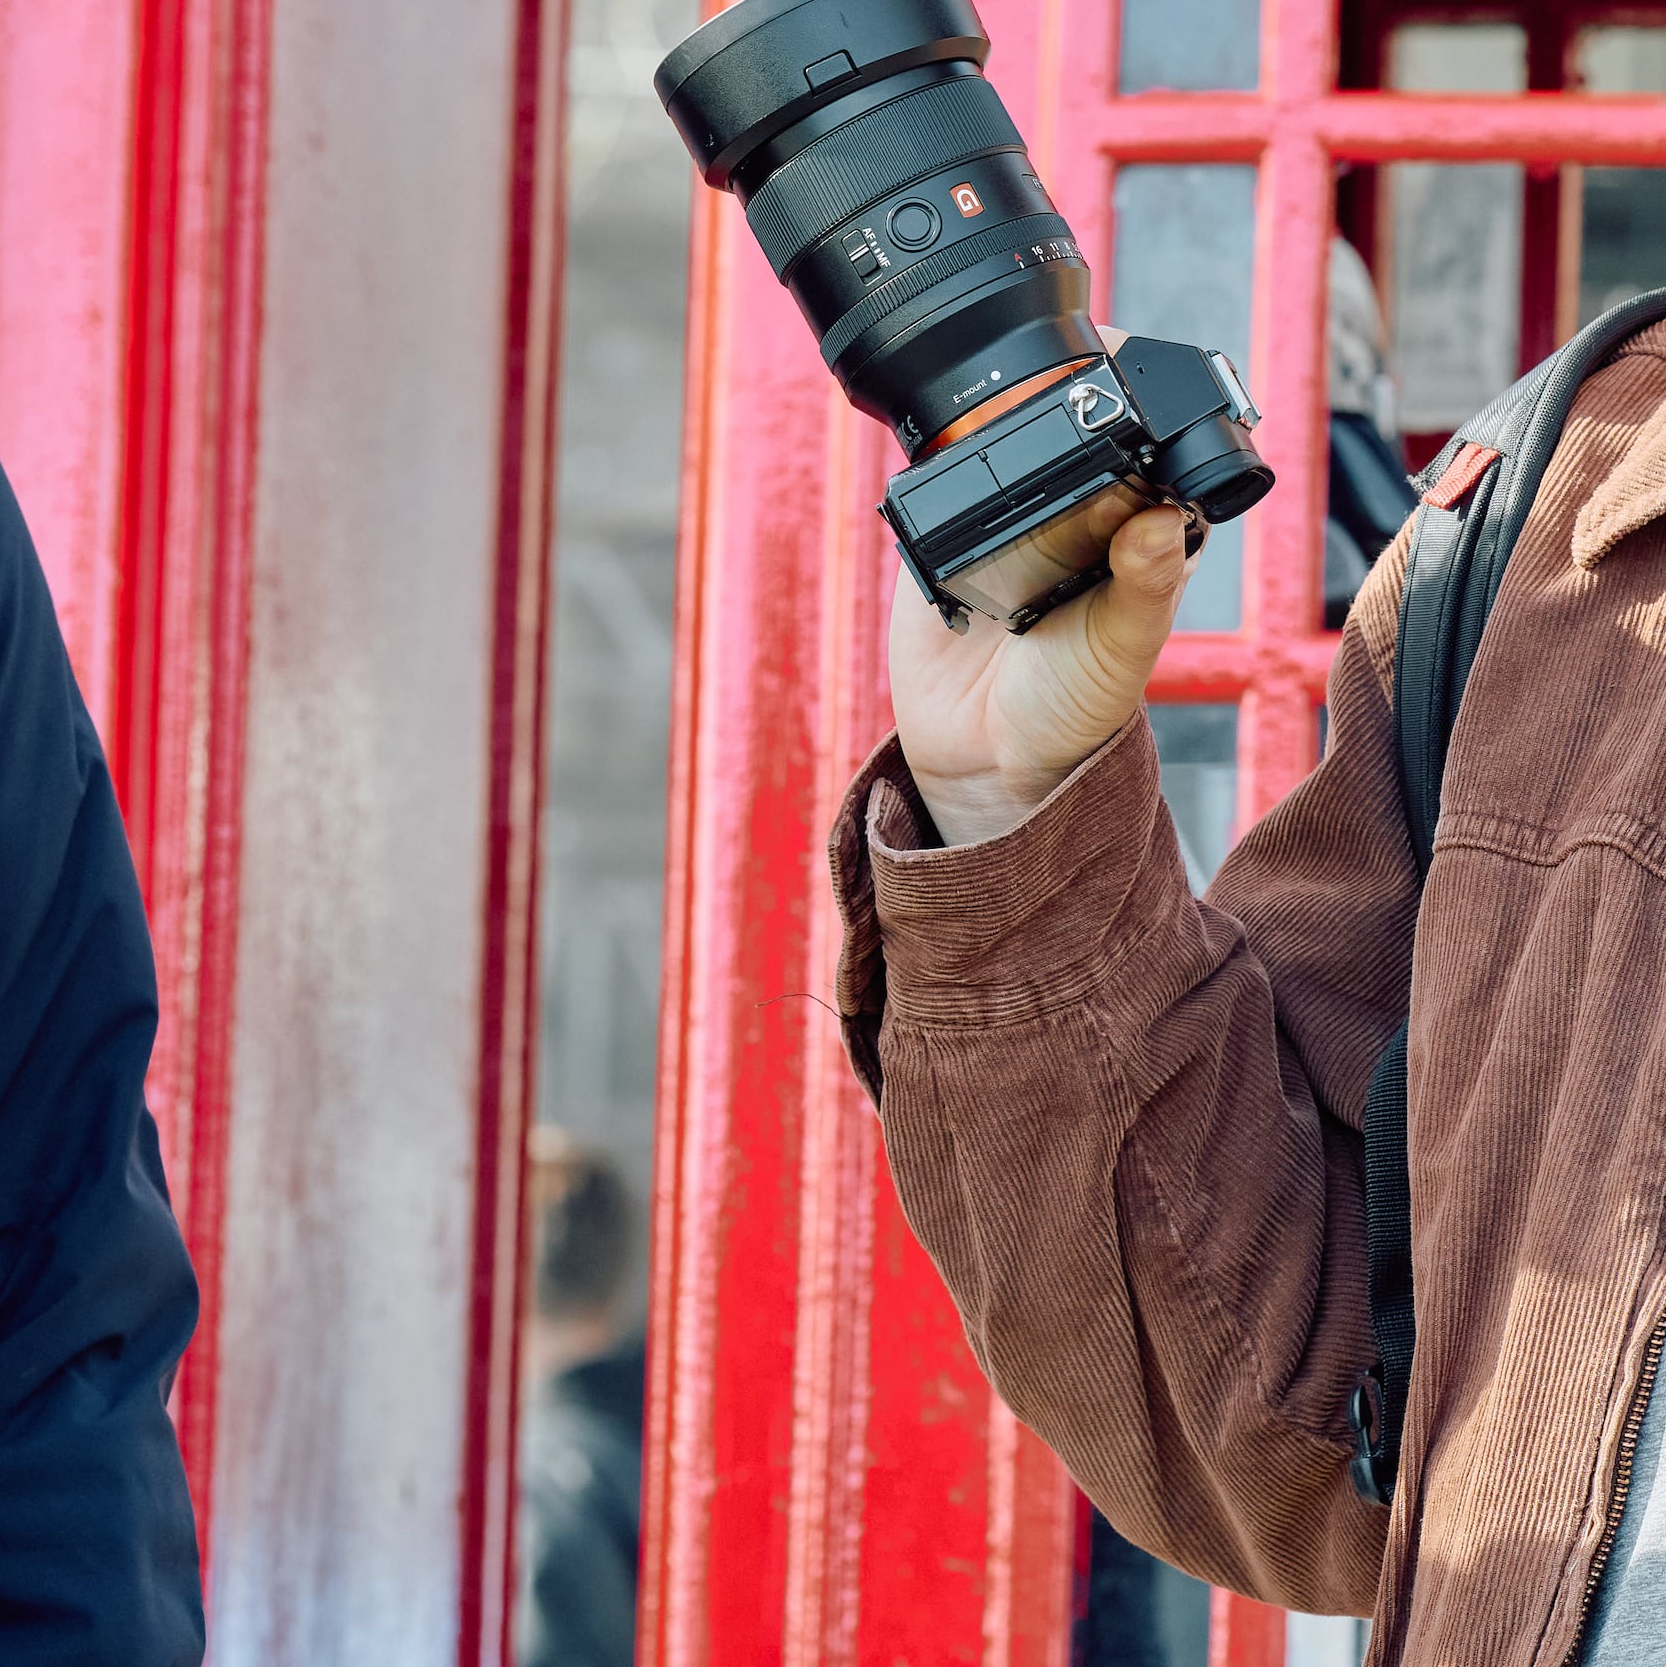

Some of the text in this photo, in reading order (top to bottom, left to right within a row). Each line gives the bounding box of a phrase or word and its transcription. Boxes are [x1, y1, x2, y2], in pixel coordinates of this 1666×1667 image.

[956, 188, 979, 212] G
[862, 227, 876, 240] AF
[1031, 245, 1043, 256] 16
[1049, 242, 1060, 252] 11
[876, 251, 891, 268] MF
[952, 379, 987, 404] E-mount
